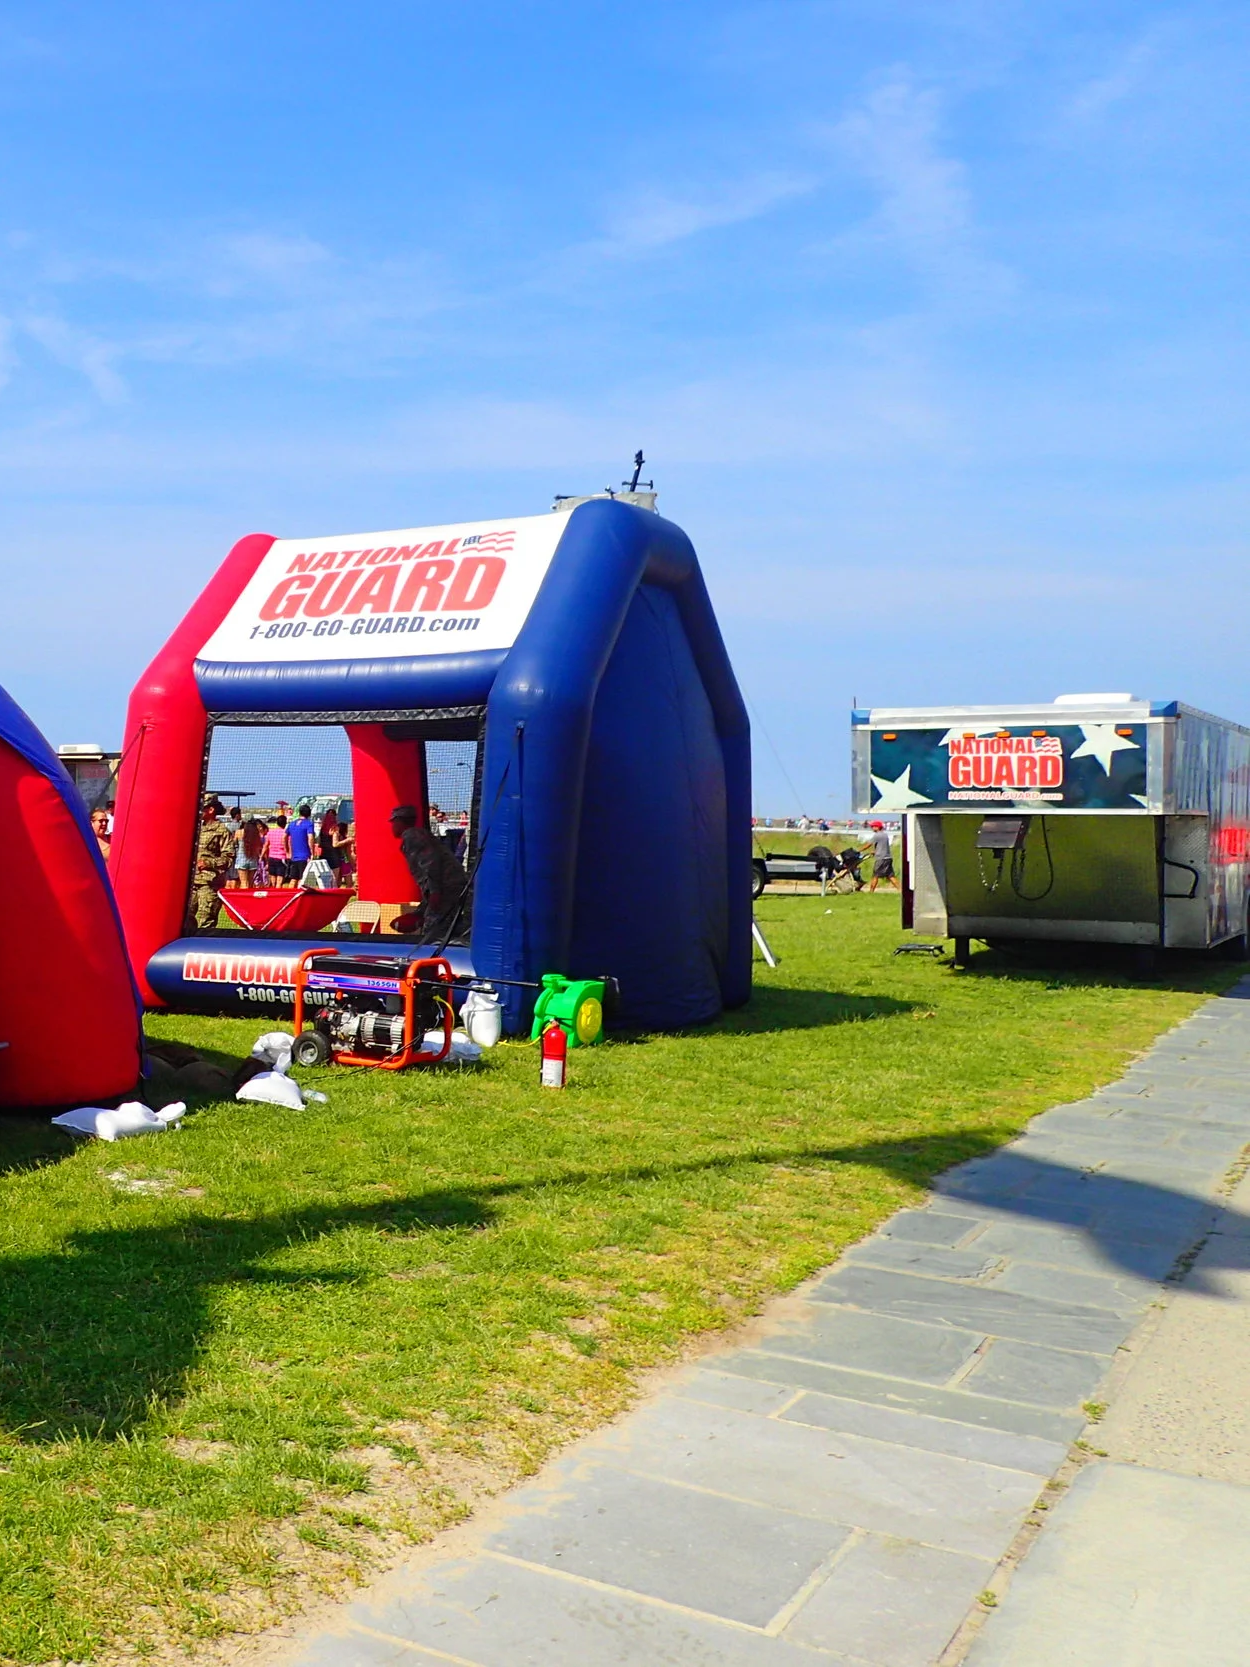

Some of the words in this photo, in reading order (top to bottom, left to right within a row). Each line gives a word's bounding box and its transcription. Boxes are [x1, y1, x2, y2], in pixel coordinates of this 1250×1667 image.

[286, 537, 463, 575] NATIONAL
[258, 556, 507, 622] GUARD
[250, 617, 480, 640] 1-800-GO-GUARD.com
[949, 738, 1036, 755] NATIONAL
[949, 755, 1062, 787] GUARD
